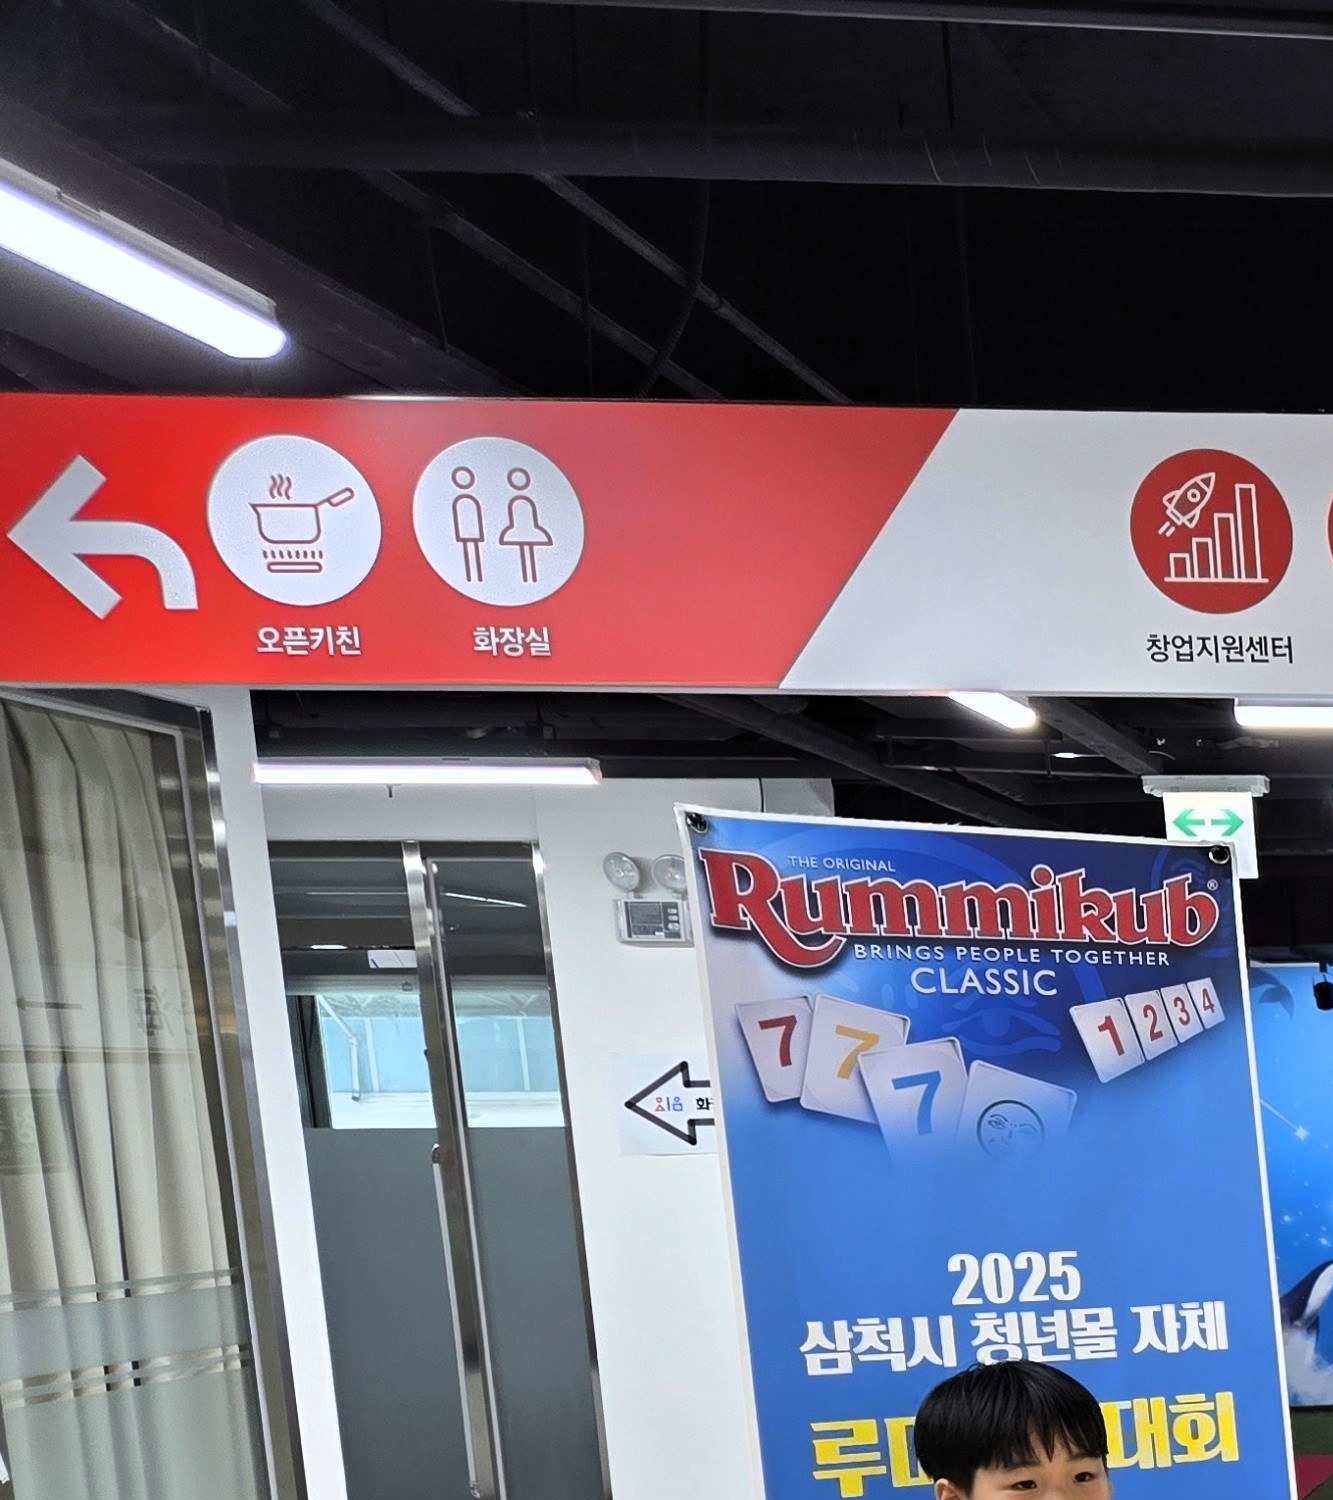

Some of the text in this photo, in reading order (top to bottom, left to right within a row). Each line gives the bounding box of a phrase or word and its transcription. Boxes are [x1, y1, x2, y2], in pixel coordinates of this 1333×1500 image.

[256, 624, 362, 657] 오픈키친
[472, 625, 552, 658] 화장실
[1145, 633, 1294, 665] 창업지원센터
[788, 855, 896, 873] THE ORIGINAL
[699, 846, 1219, 967] Rummikub
[853, 943, 1170, 967] BRINGS PEOPLE TOGETHER
[910, 966, 1058, 998] CLASSIC
[1097, 987, 1215, 1058] 1 2 3 4
[758, 1015, 943, 1136] 7 7 7
[947, 1250, 1081, 1306] 2025
[799, 1300, 1229, 1376] 삼척시 청년몰 자체
[1100, 1391, 1239, 1470] 대회
